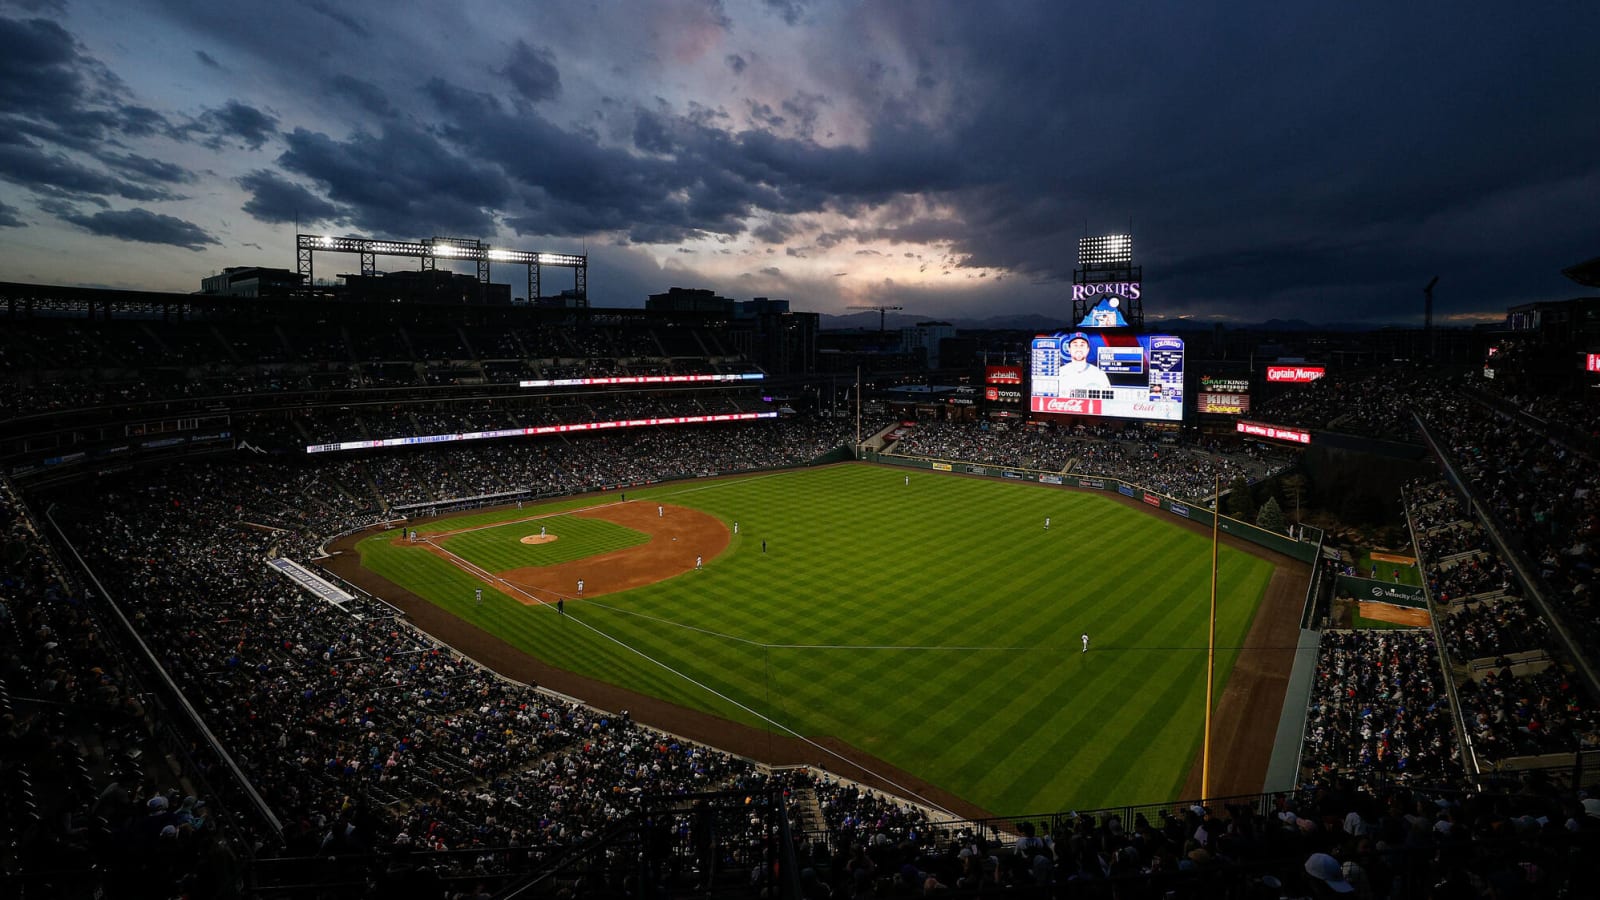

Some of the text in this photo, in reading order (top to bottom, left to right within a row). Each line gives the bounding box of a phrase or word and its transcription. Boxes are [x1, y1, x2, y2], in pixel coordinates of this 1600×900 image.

[1072, 283, 1141, 301] ROCKIES
[990, 370, 1018, 379] uchealth
[1268, 368, 1295, 381] Captain
[1207, 394, 1241, 405] KING
[1384, 589, 1410, 600] Velocity
